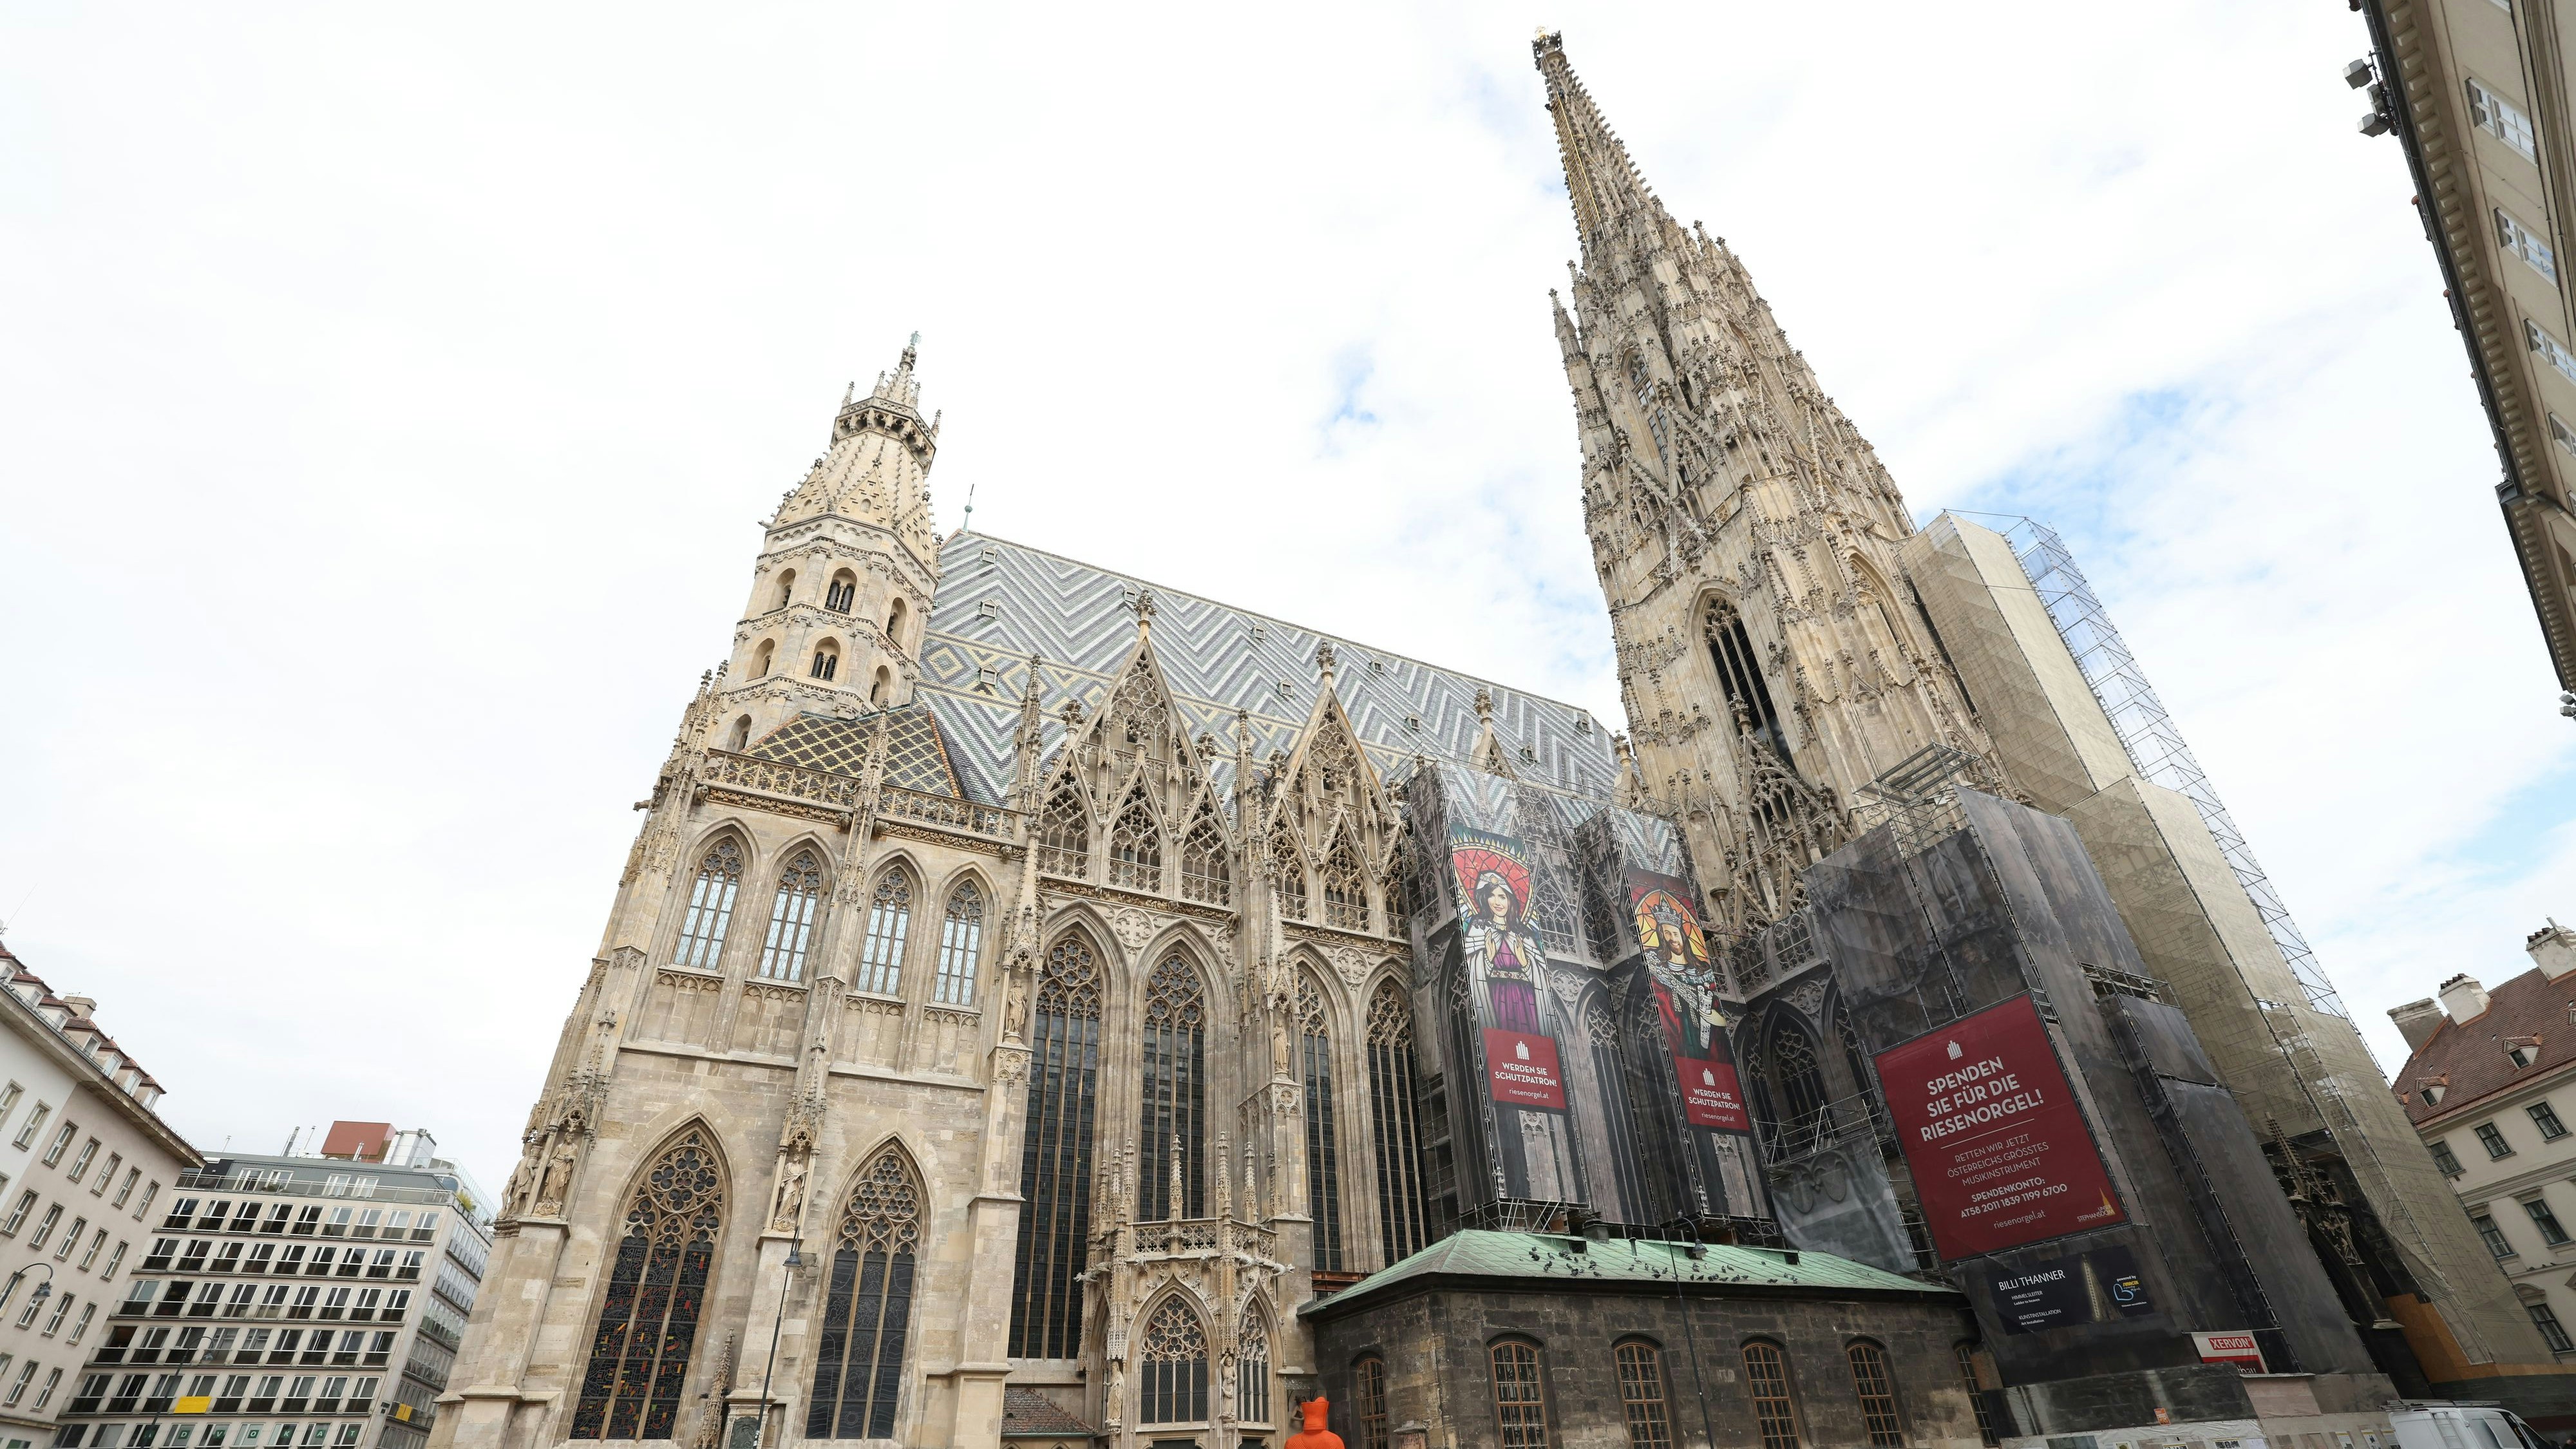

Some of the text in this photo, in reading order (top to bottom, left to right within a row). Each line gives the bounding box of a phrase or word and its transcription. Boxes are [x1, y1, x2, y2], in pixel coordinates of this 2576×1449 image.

[1502, 1062, 1548, 1075] WERDEN SIE
[1927, 1056, 2004, 1095] SPENDEN
[1495, 1071, 1557, 1086] SCHUTZPATRON!
[1509, 1088, 1549, 1099] riesenorgel.at
[1693, 1088, 1721, 1098] WERDEN
[1927, 1074, 2020, 1117] SIE FÜR DIE
[1688, 1097, 1741, 1110] SCHUTZPATRON!
[1701, 1112, 1735, 1122] riesenorgel.at
[1920, 1088, 2044, 1142] RIESENORGEL!
[1955, 1133, 2029, 1162] RETTEN WIR JETZT
[1947, 1142, 2049, 1178] ÖSTERREICHS GRÖSSTES
[1962, 1157, 2041, 1186] MUSIKINSTRUMENT
[1971, 1177, 2045, 1202] SPENDENKONTO:
[1961, 1184, 2067, 1218] AT58 2011 1839 1199 6700
[1994, 1209, 2046, 1229] riesenorgel.at
[2077, 1209, 2114, 1222] STEPHANSDOM
[1998, 1269, 2066, 1291] BILLI THANNER
[2011, 1290, 2043, 1300] HIMMELSLEITER
[2018, 1309, 2061, 1320] KUNSTINSTALLATION
[2210, 1338, 2251, 1349] XERVON
